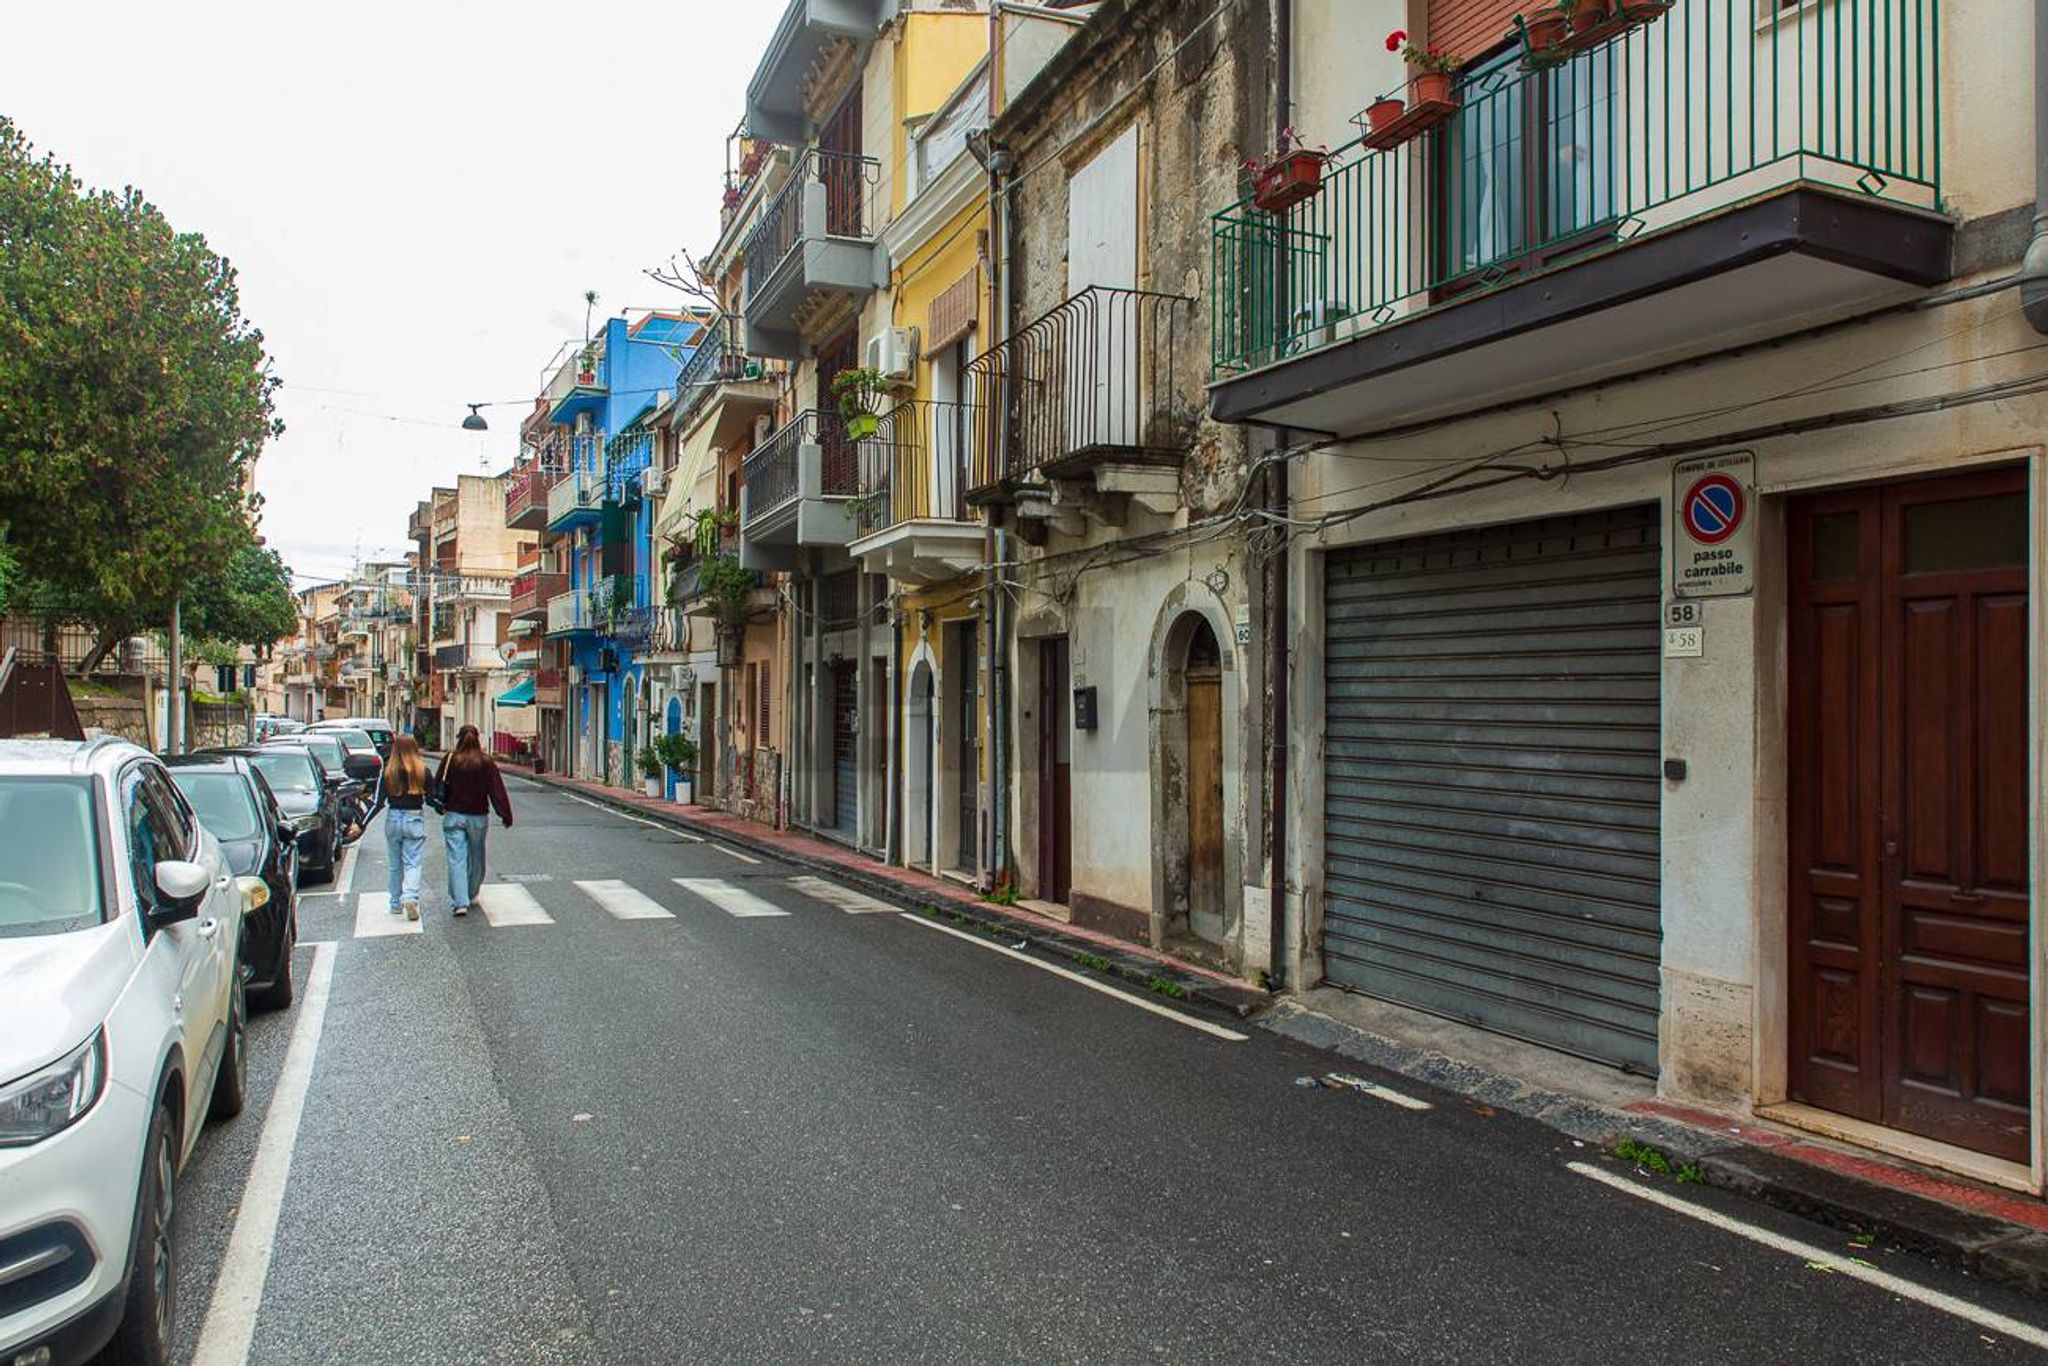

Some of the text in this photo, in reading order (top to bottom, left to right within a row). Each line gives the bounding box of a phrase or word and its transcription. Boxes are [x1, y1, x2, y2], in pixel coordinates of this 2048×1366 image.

[1693, 549, 1733, 564] passo
[1685, 562, 1743, 578] carrabile
[1672, 605, 1694, 622] 58
[1679, 633, 1697, 648] 58
